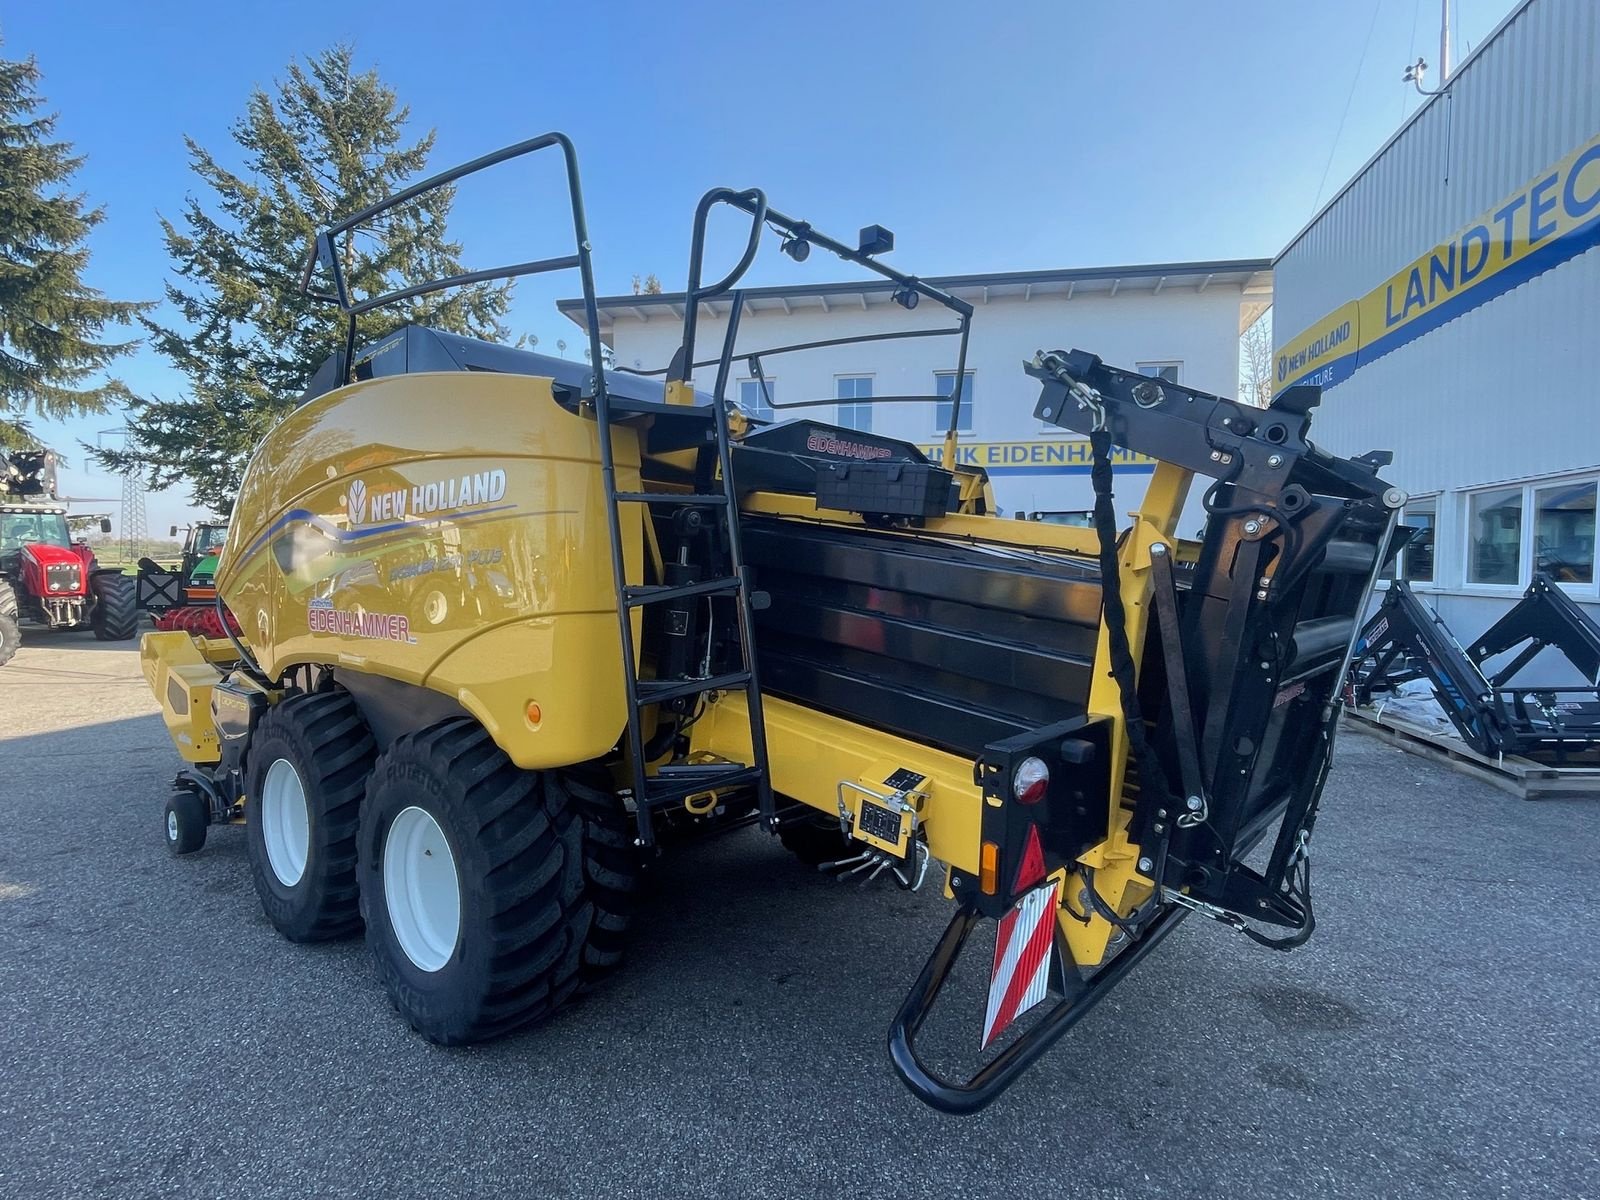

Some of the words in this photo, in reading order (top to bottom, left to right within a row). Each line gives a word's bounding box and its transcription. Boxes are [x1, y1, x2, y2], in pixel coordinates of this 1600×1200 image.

[1385, 143, 1600, 328] LANDTEC
[1288, 347, 1307, 373] NEW
[1308, 321, 1350, 362] HOLLAND
[371, 489, 407, 522] NEW
[412, 469, 506, 515] HOLLAND
[308, 608, 409, 641] EIDENHAMMER
